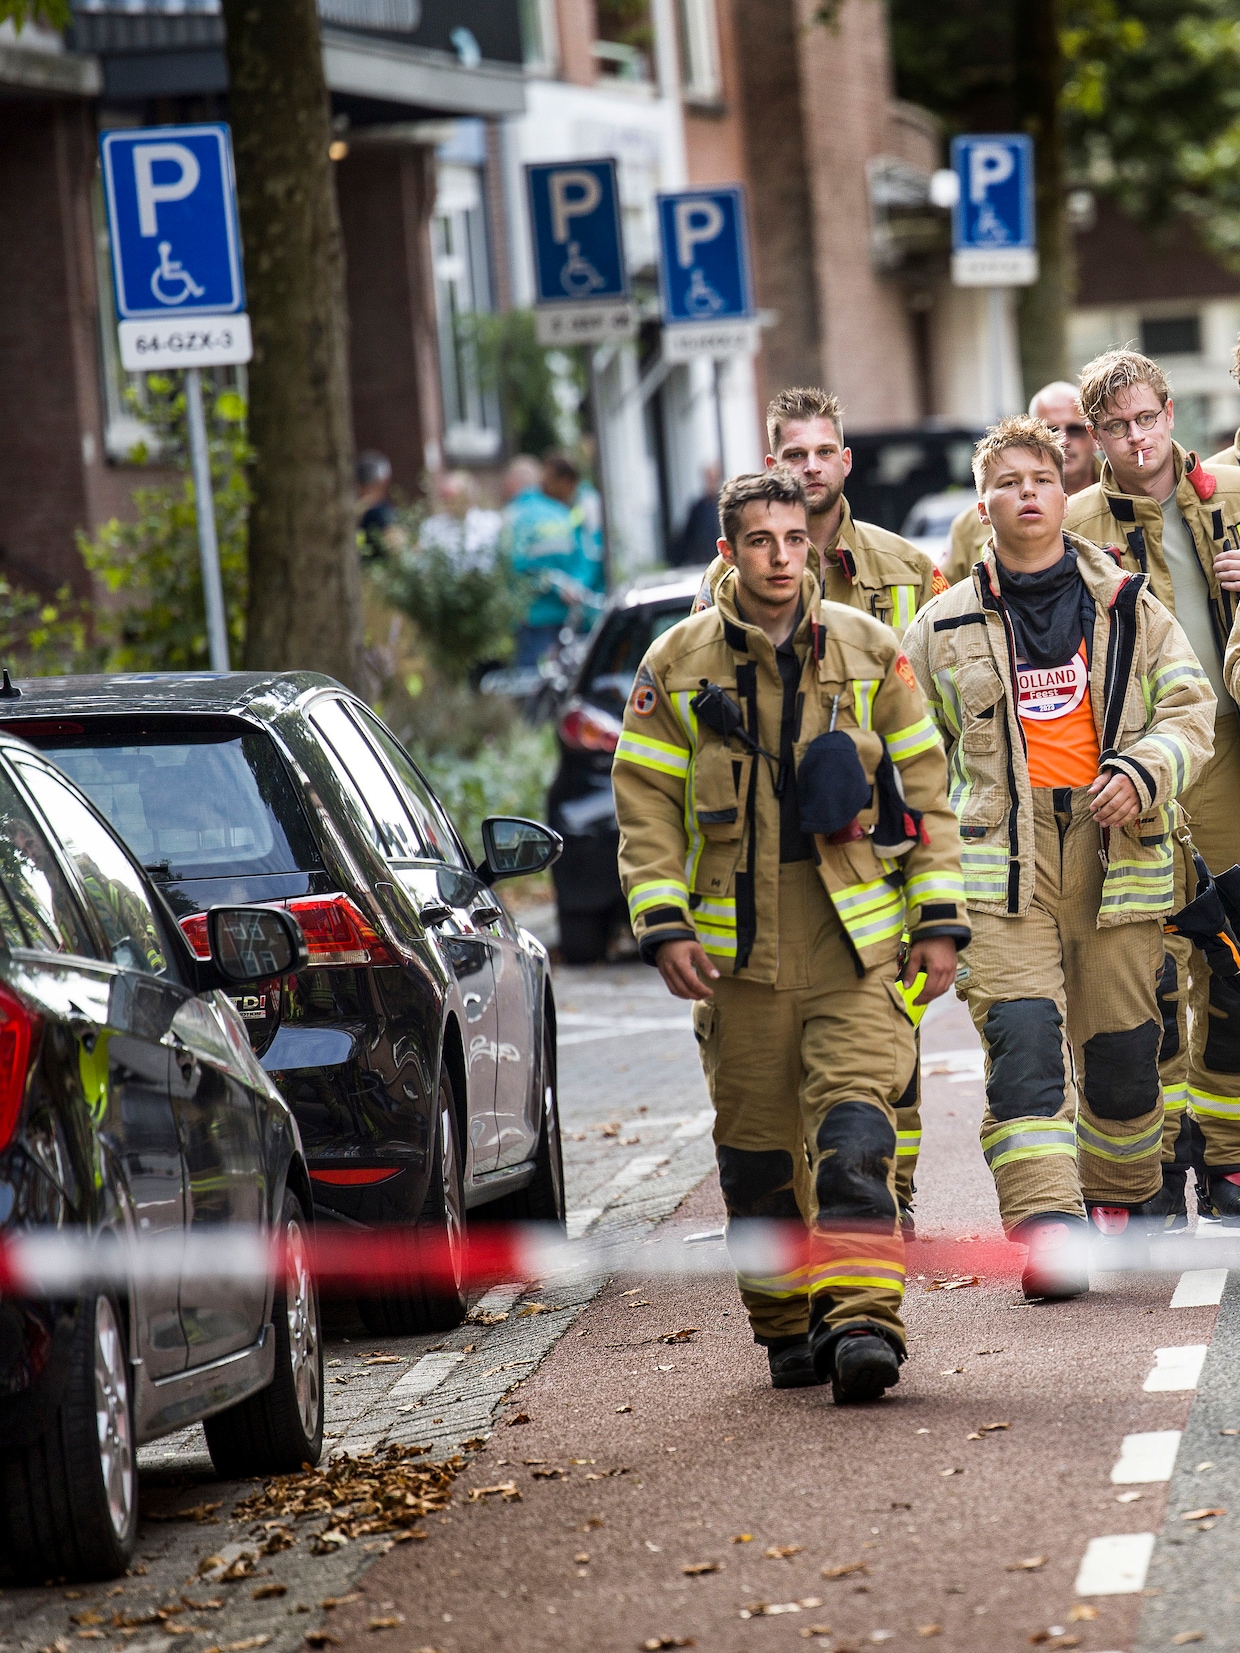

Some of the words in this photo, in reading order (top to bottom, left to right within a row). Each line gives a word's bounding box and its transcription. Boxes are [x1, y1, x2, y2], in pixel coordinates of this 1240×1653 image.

[132, 142, 201, 238] P
[970, 142, 1015, 204] P
[548, 170, 602, 244] P
[674, 199, 724, 269] P
[135, 328, 234, 355] 64-GZX-3
[1019, 669, 1076, 690] OLLAND
[1030, 688, 1059, 700] Feest
[228, 995, 267, 1010] TDI
